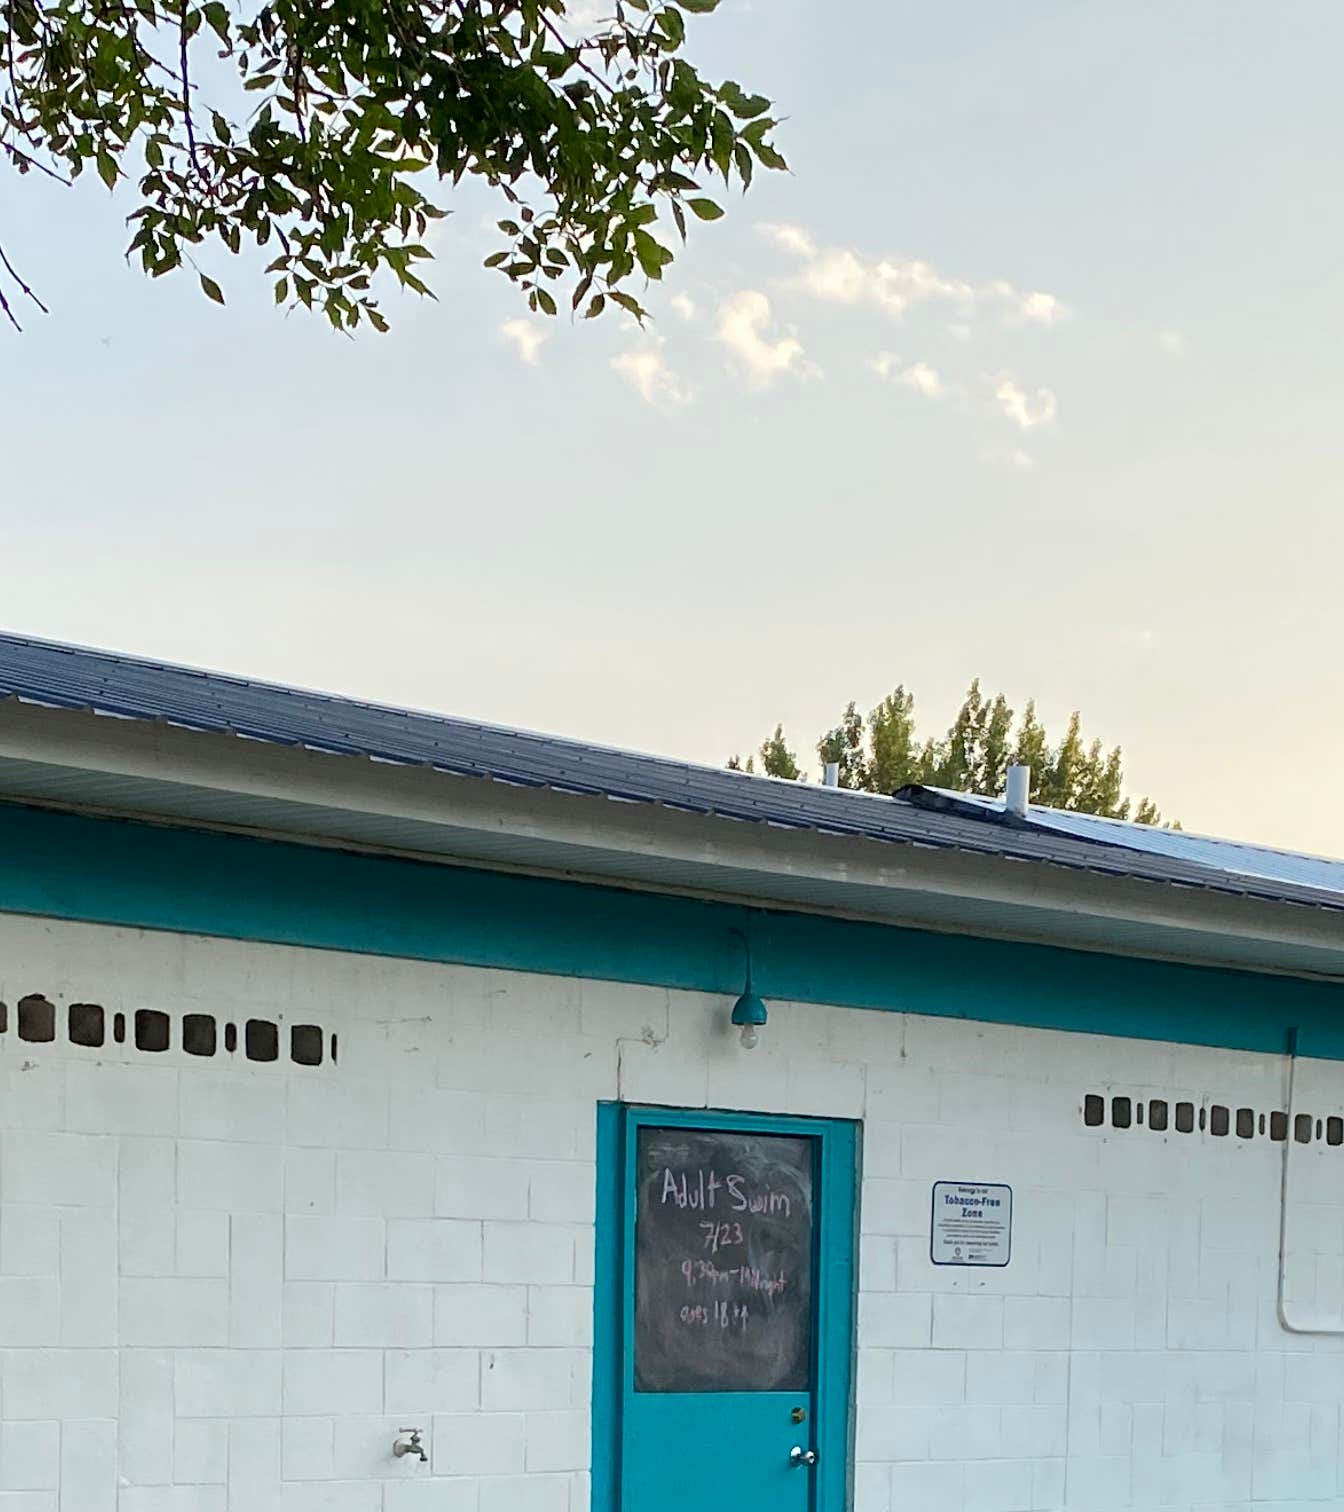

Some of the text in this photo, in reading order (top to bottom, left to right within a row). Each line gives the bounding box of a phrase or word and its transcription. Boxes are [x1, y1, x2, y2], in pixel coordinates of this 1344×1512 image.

[661, 1167, 790, 1217] Adult Swim
[944, 1194, 1001, 1207] Tobacco-Free
[961, 1207, 984, 1218] Zone
[699, 1219, 744, 1255] 7/23
